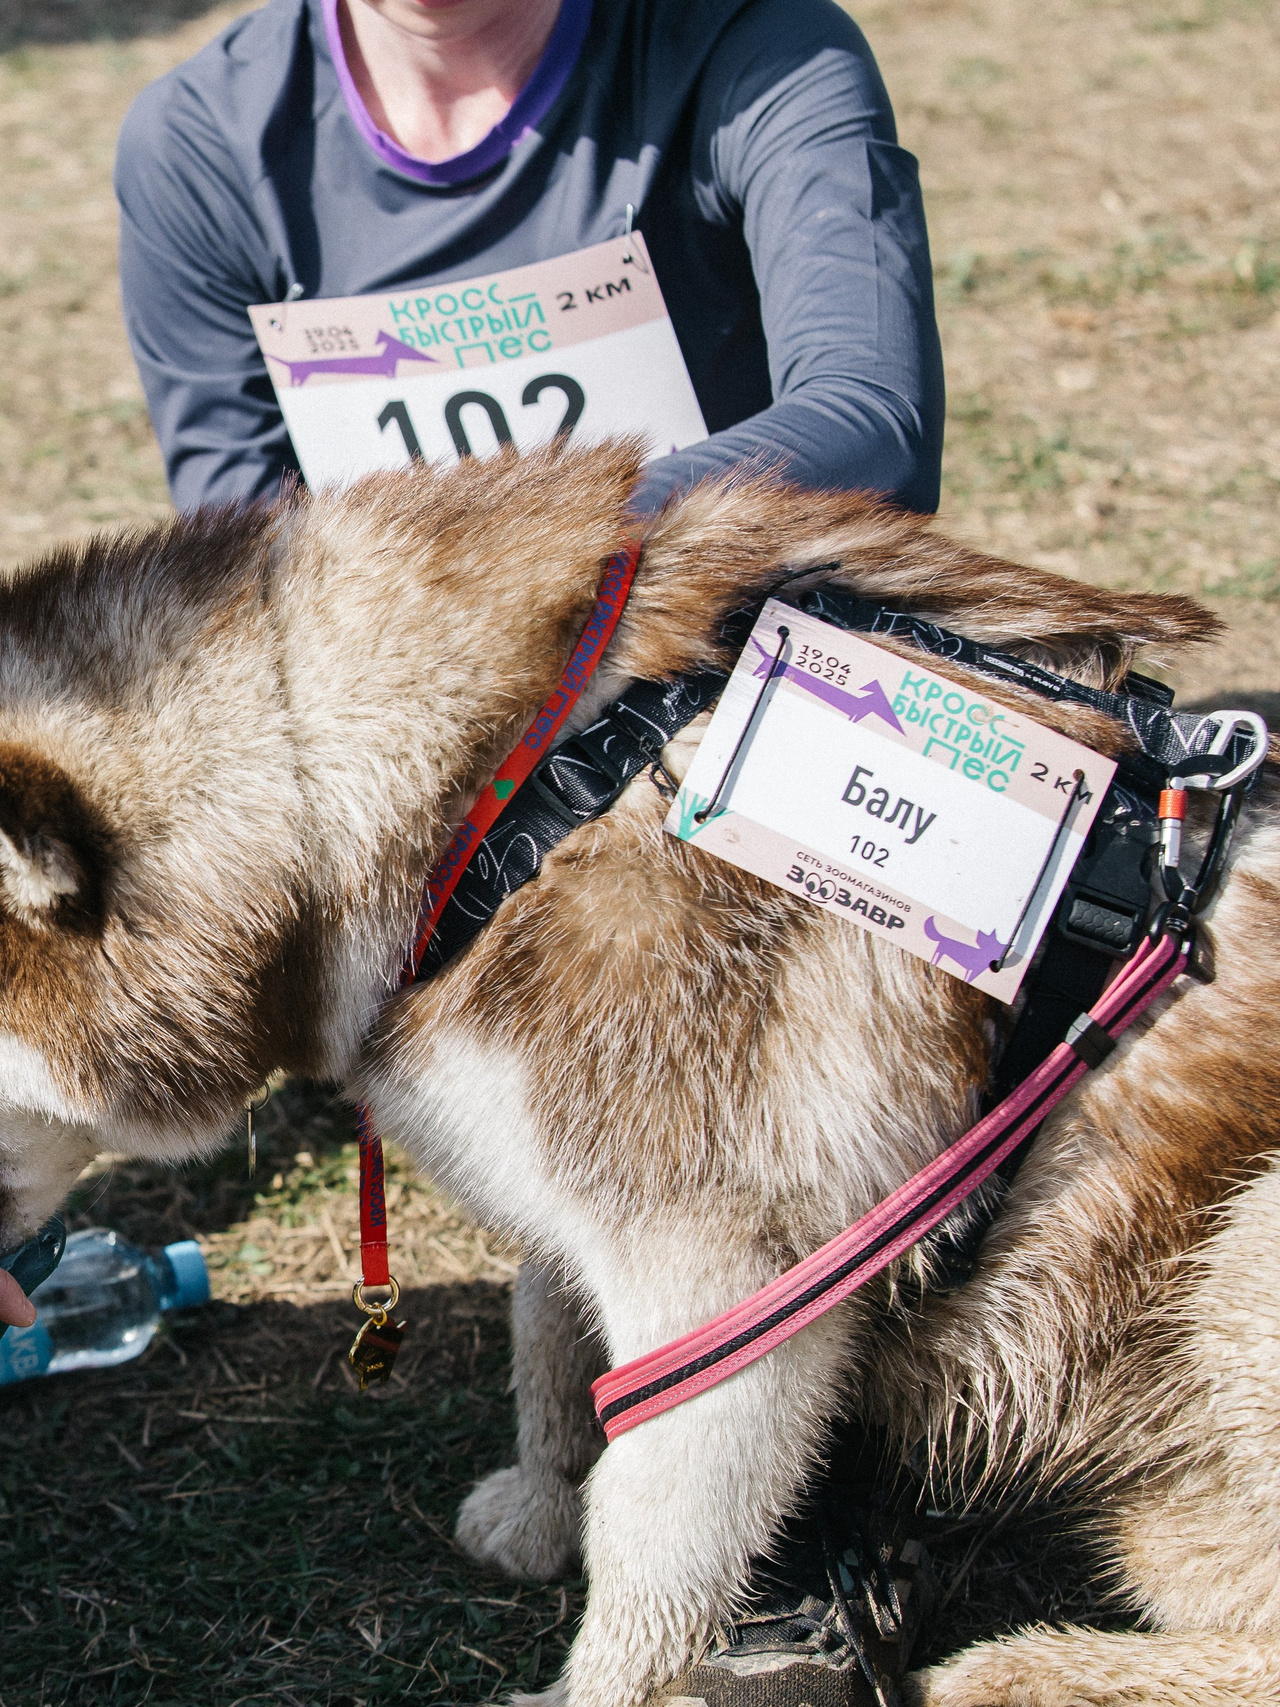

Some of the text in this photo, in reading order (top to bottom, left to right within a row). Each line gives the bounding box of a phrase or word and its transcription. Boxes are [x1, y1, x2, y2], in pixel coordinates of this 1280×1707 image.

[389, 283, 505, 323] КРОСС
[398, 293, 546, 347] БЫСТРЫЙ
[556, 291, 578, 311] 2
[562, 600, 614, 693] БЫСТРЫЙ
[795, 656, 848, 686] 2025
[800, 645, 851, 674] 19.04
[900, 670, 1005, 736] КРОСС
[892, 693, 1026, 772] БЫСТРЫЙ
[1030, 762, 1049, 782] 2
[841, 765, 938, 844] Балу
[430, 820, 478, 892] КРОСС
[850, 835, 890, 868] 102
[796, 851, 912, 912] СЕТЬ ЗООМАГАЗИНОВ
